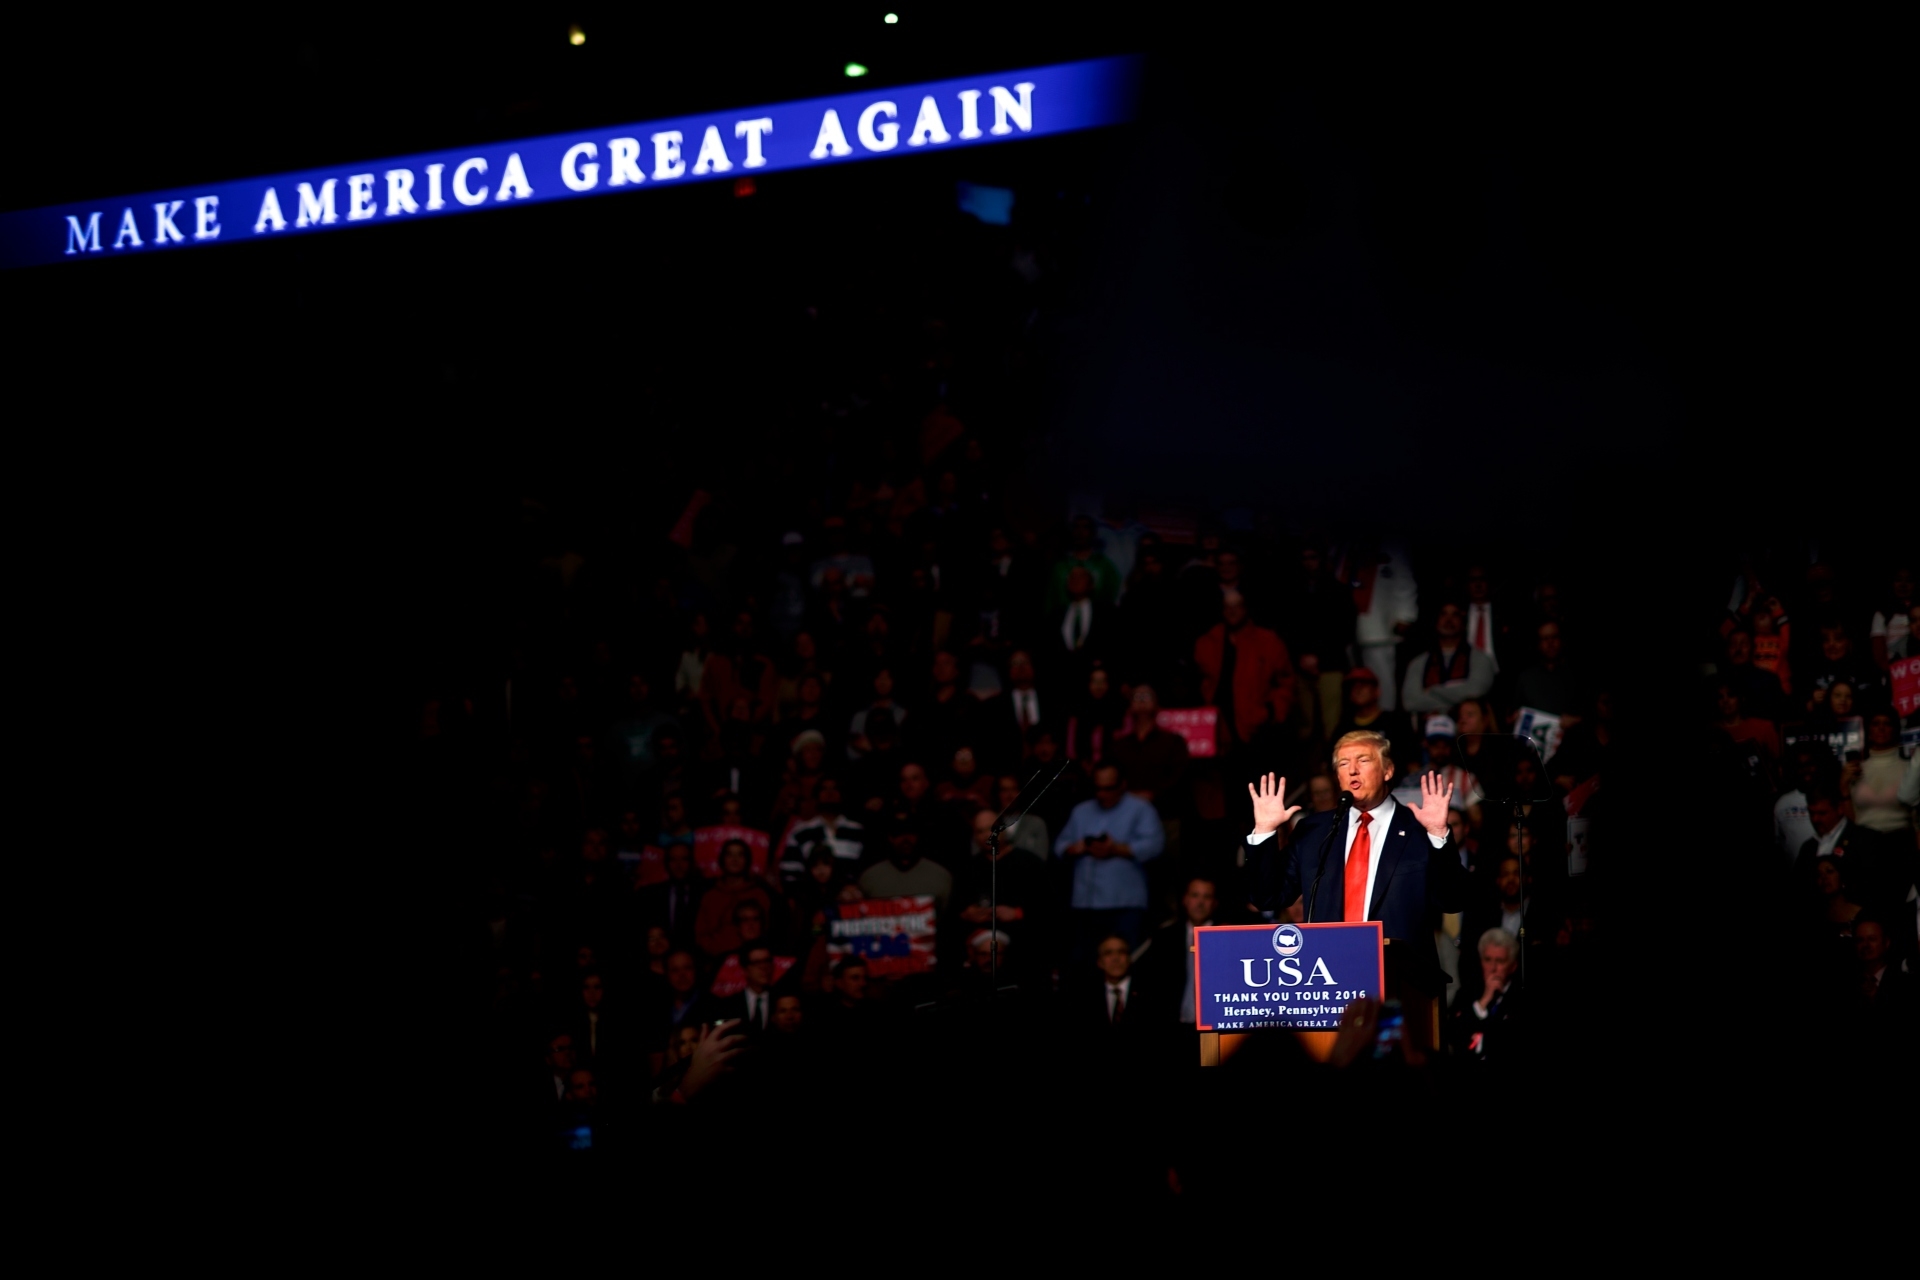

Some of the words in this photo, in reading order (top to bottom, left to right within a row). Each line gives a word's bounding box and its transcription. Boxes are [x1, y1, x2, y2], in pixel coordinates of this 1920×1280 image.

[65, 195, 222, 256] MAKE
[254, 152, 534, 233] AMERICA
[560, 117, 775, 192] GREAT
[809, 81, 1037, 160] AGAIN
[1239, 956, 1339, 988] USA
[1213, 992, 1259, 1003] THANK
[1263, 991, 1290, 1002] YOU
[1294, 991, 1330, 1001] TOUR
[1335, 990, 1366, 1000] 2016
[1223, 1005, 1275, 1018] Hershey,
[1217, 1021, 1245, 1029] MAKE
[1248, 1020, 1294, 1028] AMERICA
[1296, 1019, 1328, 1027] GREAT
